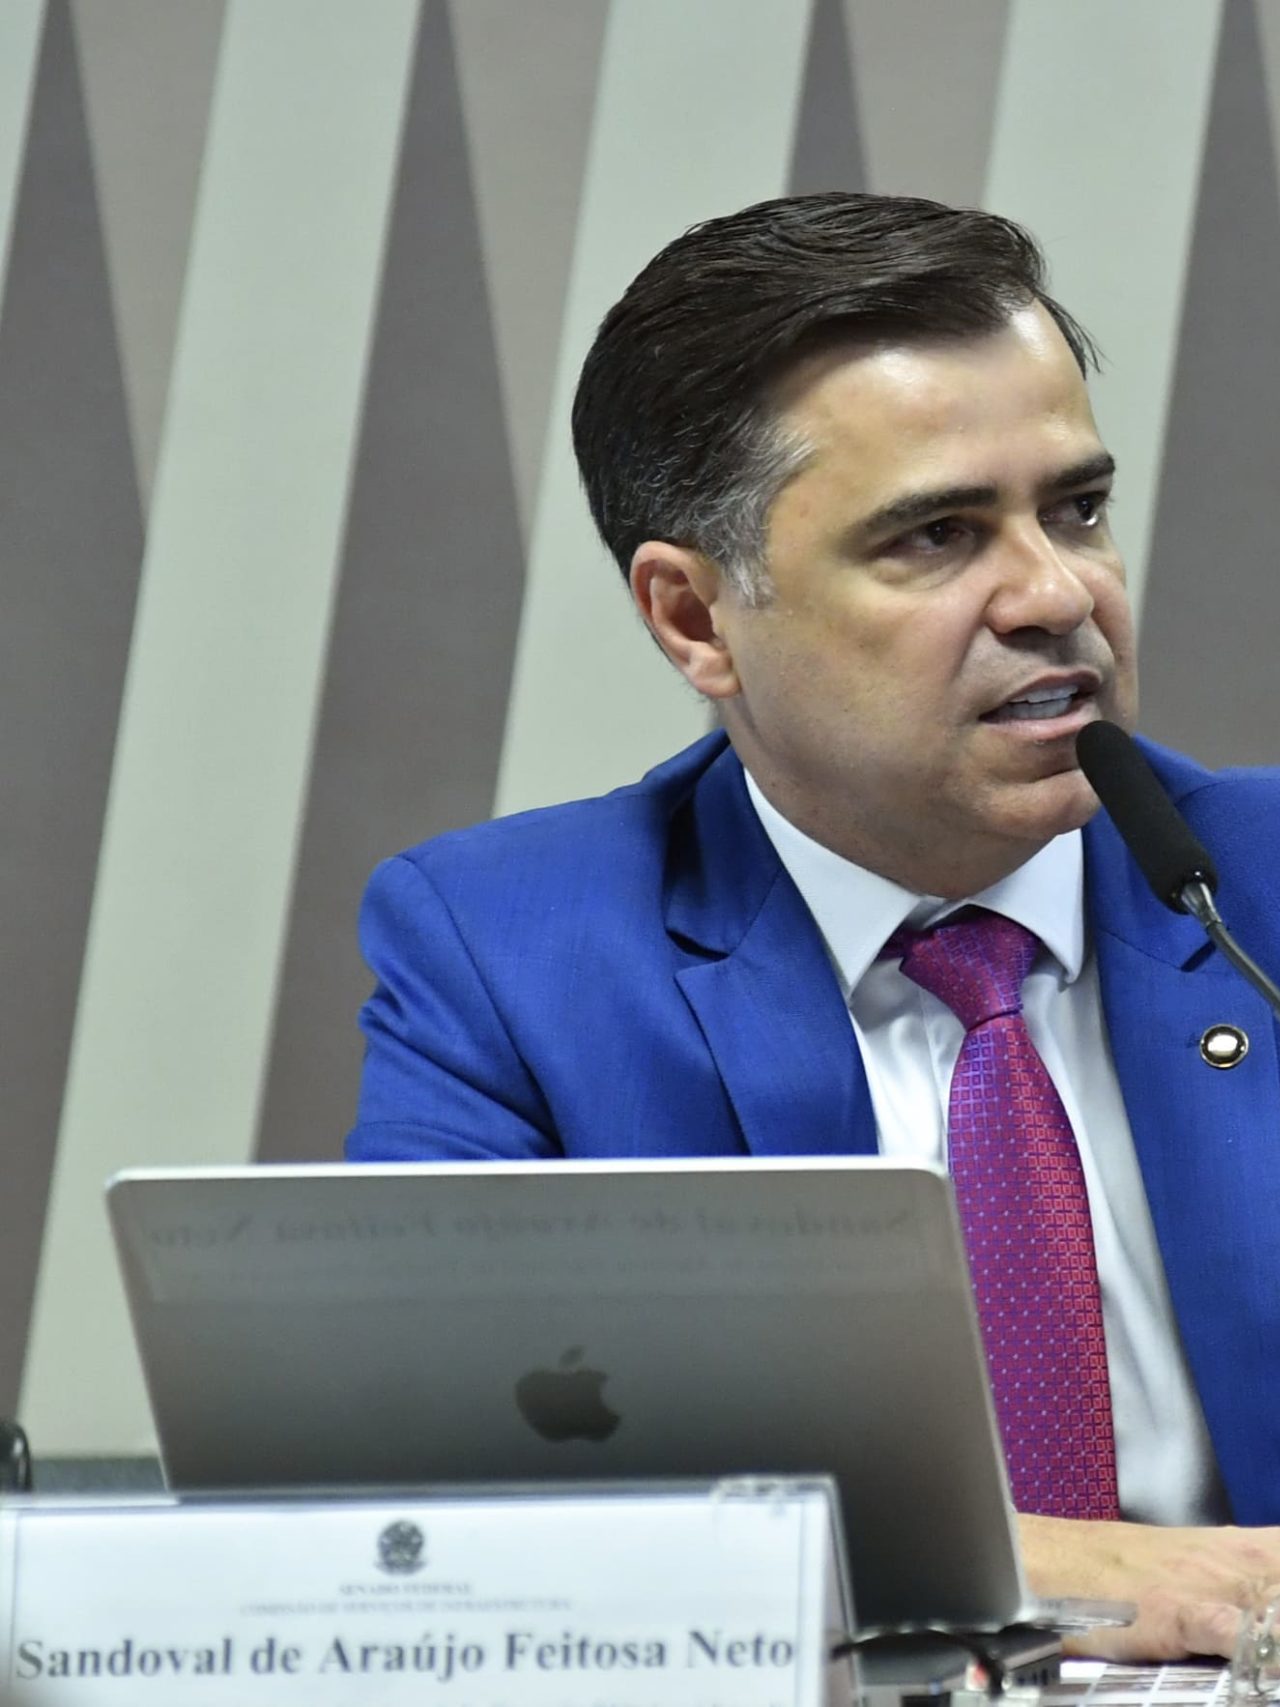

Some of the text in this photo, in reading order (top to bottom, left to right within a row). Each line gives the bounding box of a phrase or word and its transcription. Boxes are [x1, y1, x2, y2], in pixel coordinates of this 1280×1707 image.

[15, 1629, 795, 1683] Sandoval de Araújo Feitosa Neto
